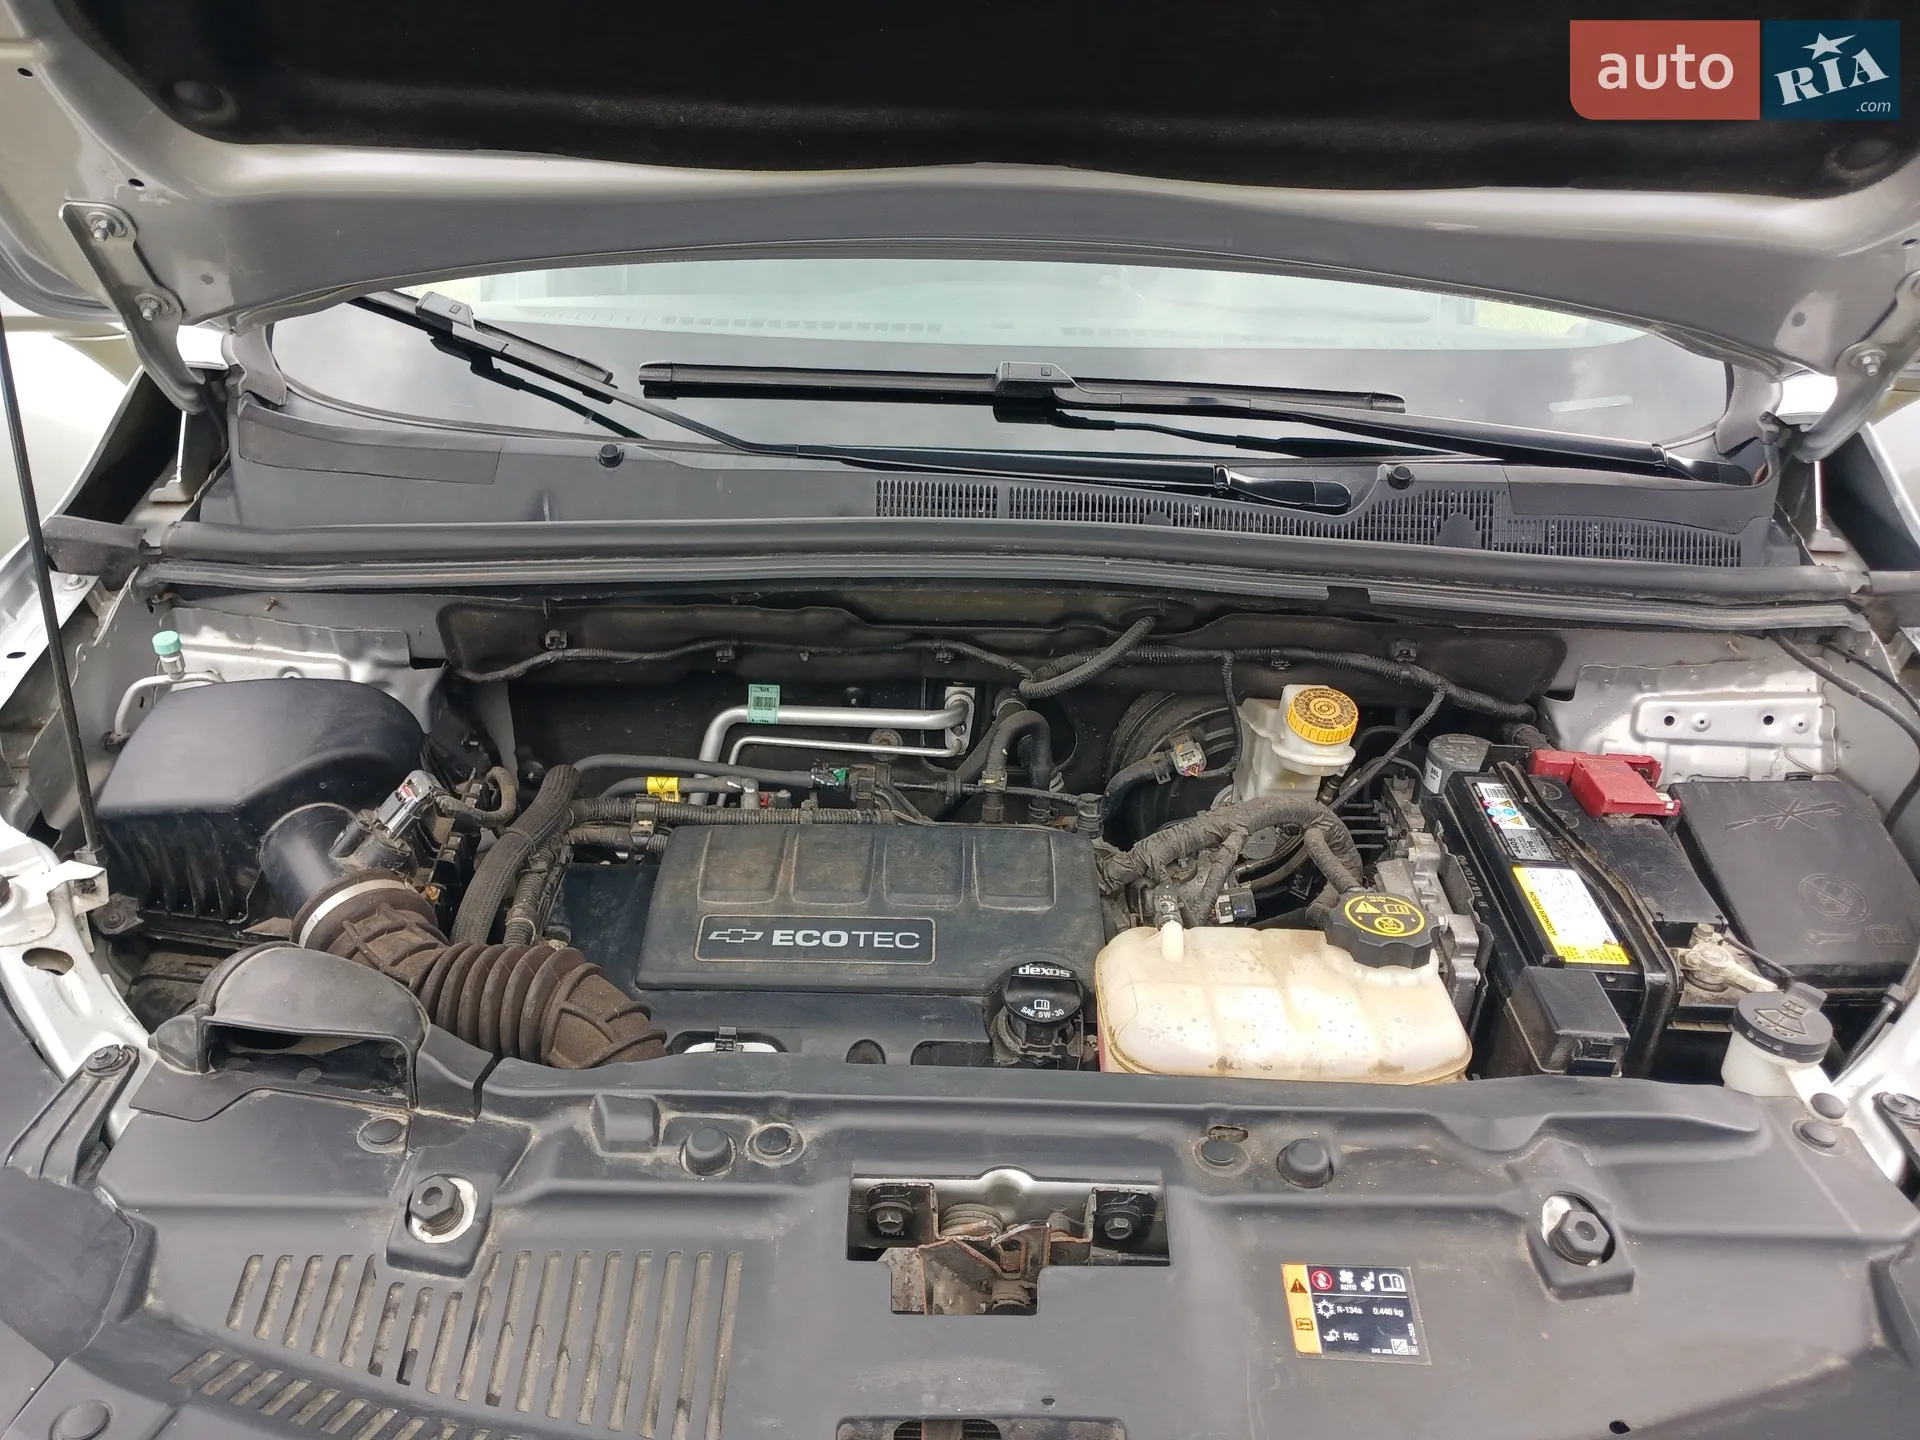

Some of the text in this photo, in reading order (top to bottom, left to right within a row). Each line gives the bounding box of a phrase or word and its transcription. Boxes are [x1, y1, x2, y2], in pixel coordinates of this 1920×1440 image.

[772, 929, 920, 949] ECOTEC
[1018, 964, 1073, 978] dexos
[1021, 1006, 1065, 1019] SAE 5W-30
[1336, 1306, 1404, 1318] R-134a 0.440 kg
[1343, 1332, 1359, 1341] PAG
